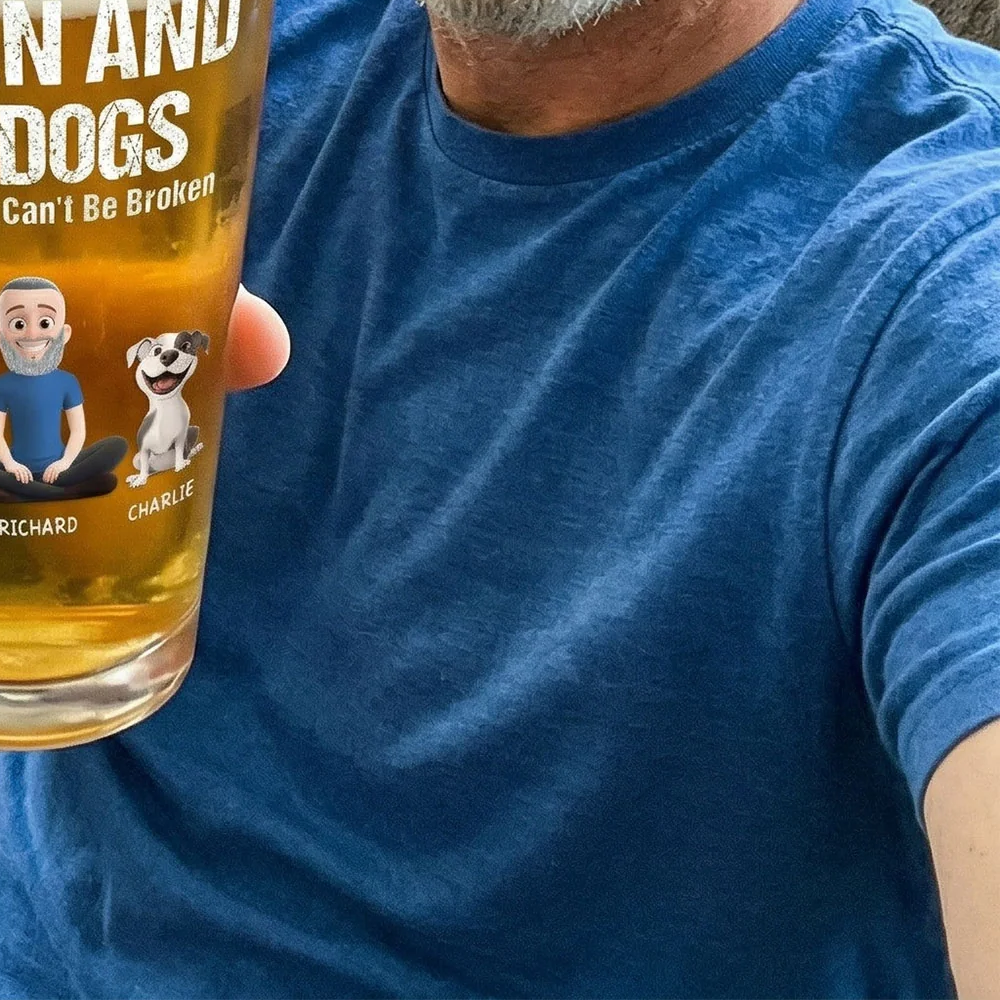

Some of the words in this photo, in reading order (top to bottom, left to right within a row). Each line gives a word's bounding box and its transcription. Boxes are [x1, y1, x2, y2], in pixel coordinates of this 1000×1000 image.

[3, 195, 73, 225] Can't
[83, 194, 118, 223] Be
[126, 170, 216, 215] Broken
[127, 479, 195, 522] CHARLIE
